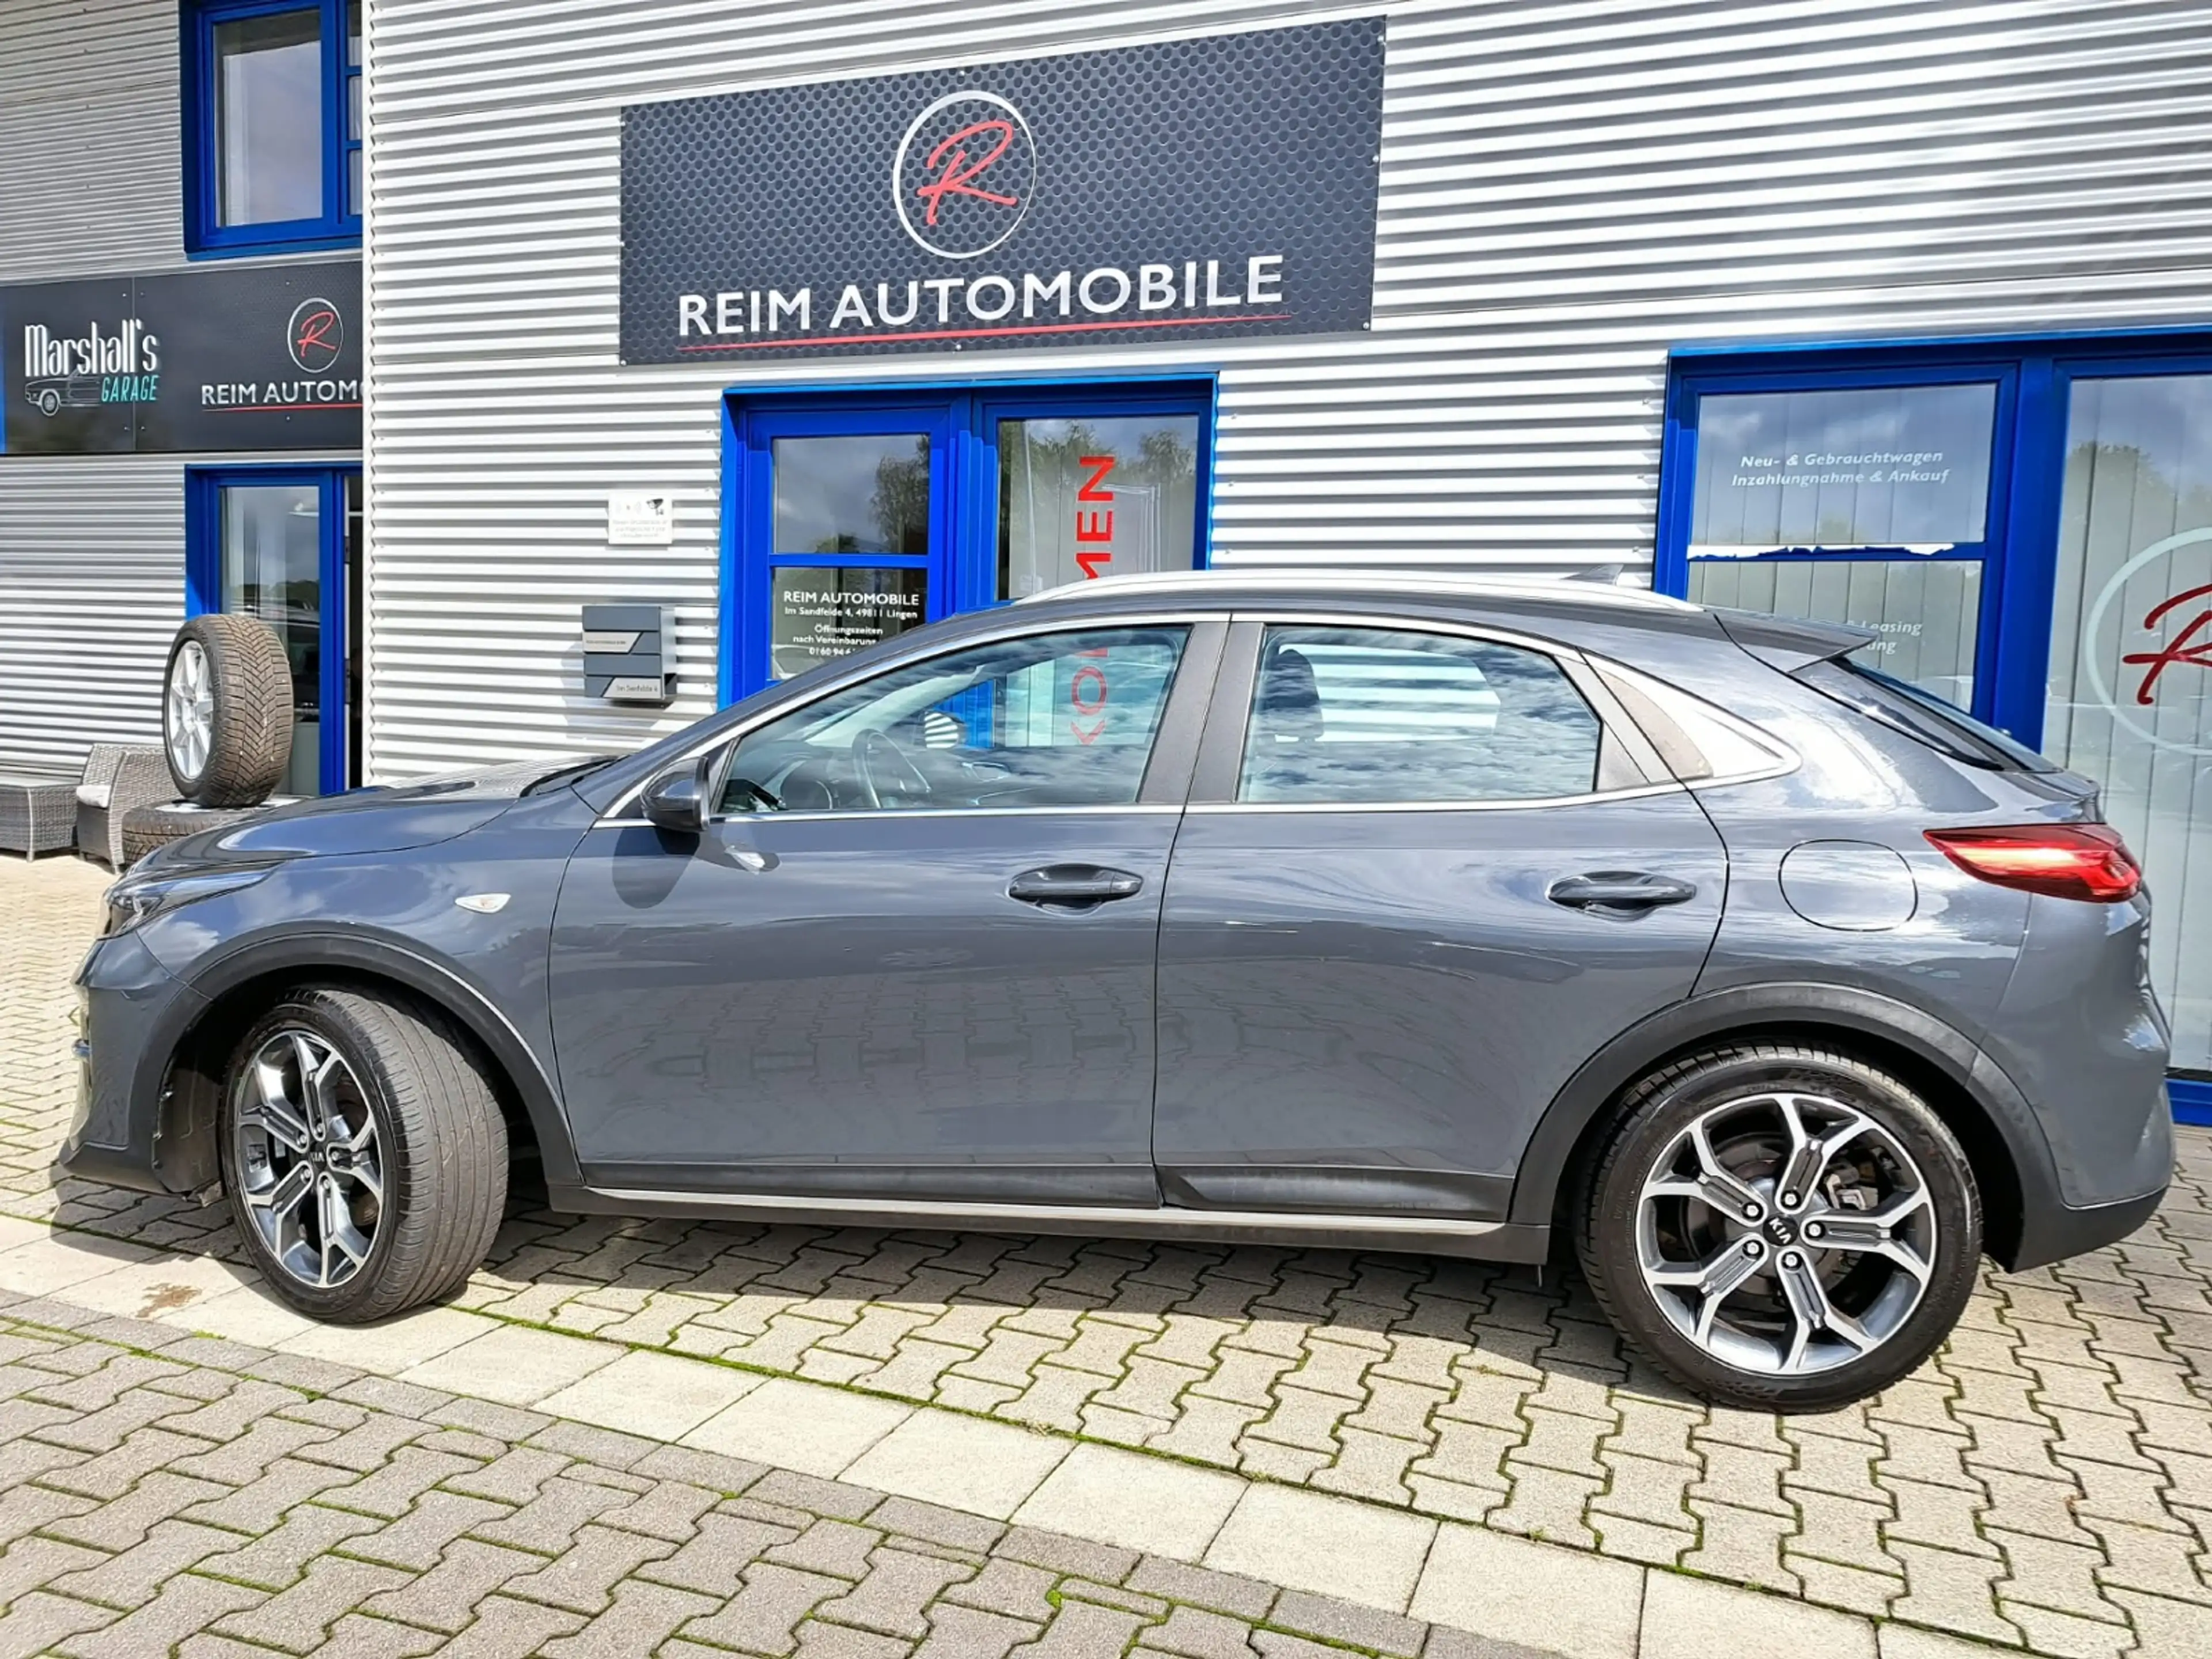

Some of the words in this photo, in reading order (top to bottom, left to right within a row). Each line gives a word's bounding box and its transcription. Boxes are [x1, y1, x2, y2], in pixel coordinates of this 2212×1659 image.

[917, 120, 1018, 225] R
[679, 288, 810, 336] REIM
[830, 255, 1283, 328] AUTOMOBILE
[25, 319, 157, 377] Marshall's
[101, 375, 158, 402] GARAGE
[202, 383, 256, 404] REIM
[1740, 456, 1780, 468] Neu-
[1786, 454, 1798, 465] &
[1805, 452, 1943, 466] Gebrauchtwagen
[1732, 471, 1864, 487] Inzahlungnahme
[1869, 471, 1883, 482] &
[1887, 468, 1950, 484] Ankauf
[784, 591, 817, 603] REIM
[820, 593, 919, 605] AUTOMOBILE
[887, 610, 918, 620] Lingen
[793, 634, 814, 643] nach
[1768, 1217, 1791, 1244] KIA
